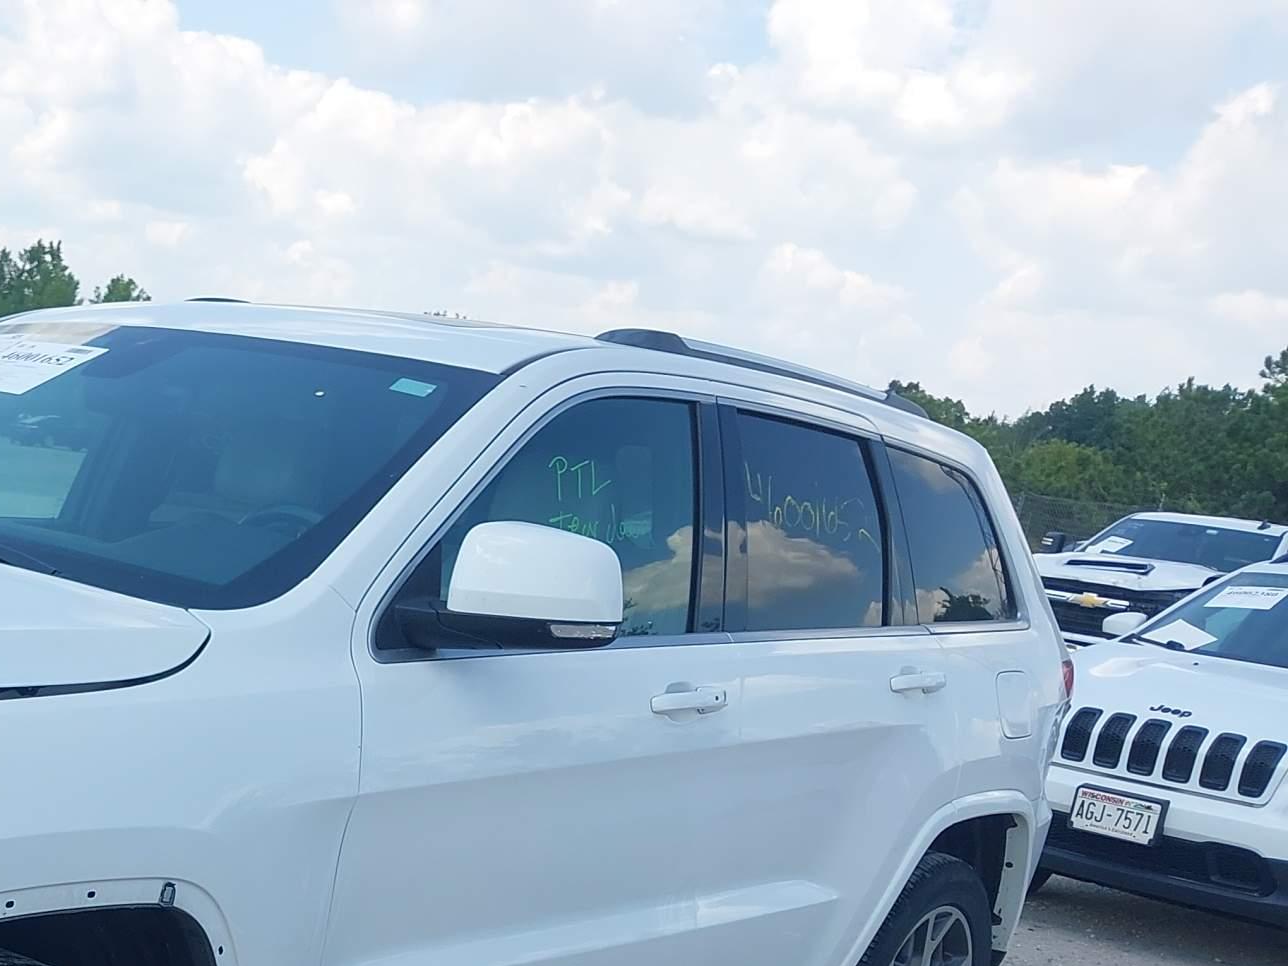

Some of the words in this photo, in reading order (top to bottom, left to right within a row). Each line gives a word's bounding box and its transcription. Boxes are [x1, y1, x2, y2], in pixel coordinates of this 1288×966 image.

[548, 456, 612, 501] PTL
[1149, 704, 1192, 717] Jeep
[1081, 789, 1126, 806] WISCONSIN
[1075, 799, 1152, 834] AGJ-7571
